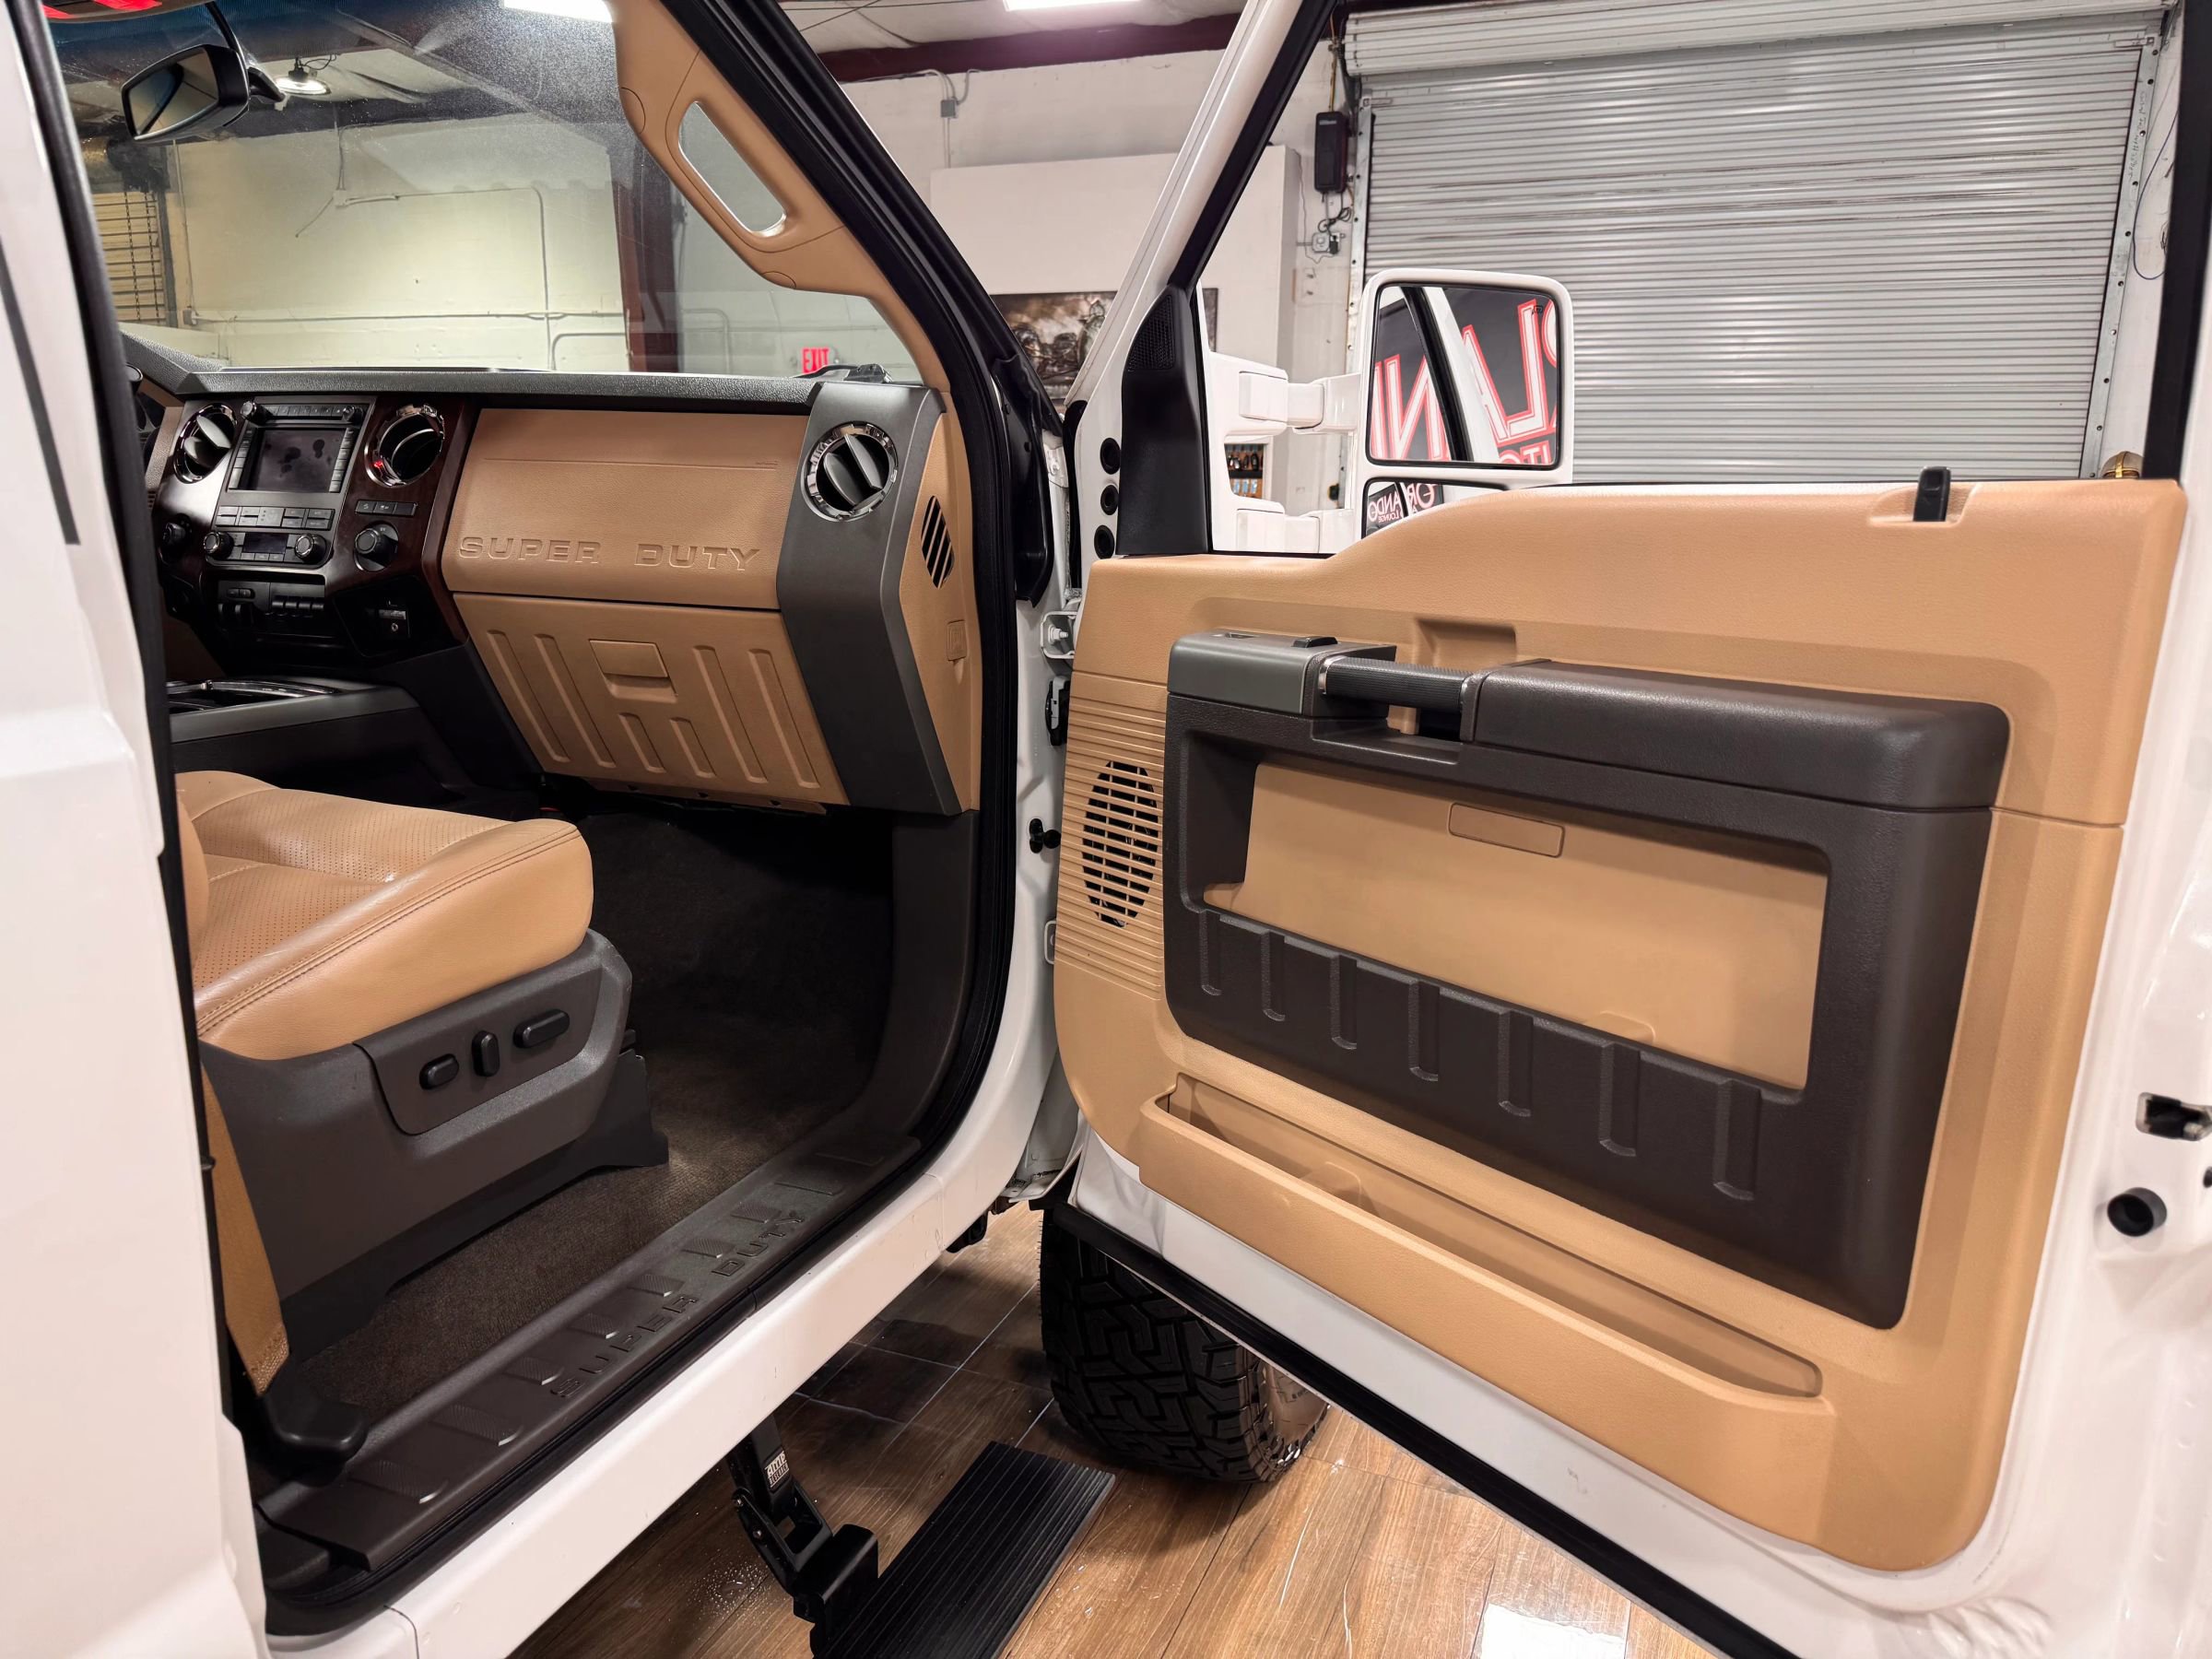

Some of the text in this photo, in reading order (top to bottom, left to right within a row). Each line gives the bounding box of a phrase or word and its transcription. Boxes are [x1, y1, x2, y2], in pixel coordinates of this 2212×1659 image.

[802, 347, 830, 373] EXIT
[459, 536, 759, 571] SUPER DUTY
[550, 1210, 804, 1397] SUPER DUTY
